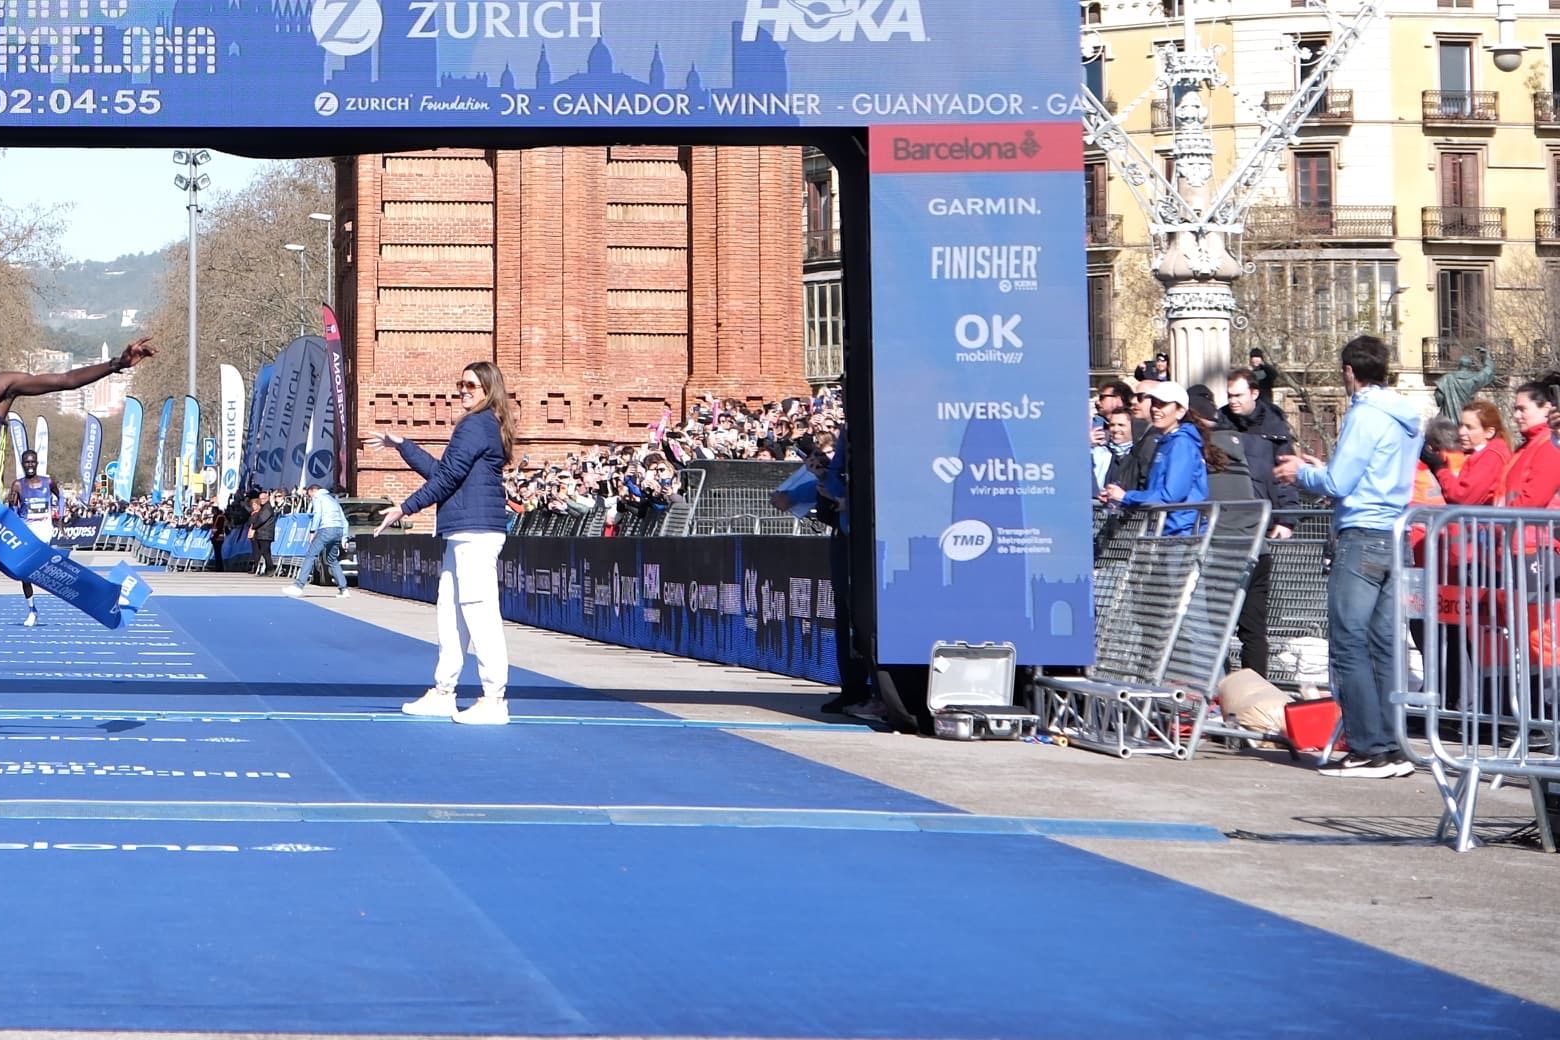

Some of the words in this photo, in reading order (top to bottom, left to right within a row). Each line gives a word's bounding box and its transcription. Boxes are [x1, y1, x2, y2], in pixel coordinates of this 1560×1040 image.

[407, 1, 602, 39] ZURICH
[345, 97, 409, 111] ZURICH
[418, 94, 490, 112] Foundation
[552, 94, 690, 116] GANADOR
[717, 94, 821, 116] WINNER
[851, 93, 1024, 116] GUANYADOR
[893, 137, 1018, 160] Barcelona
[931, 245, 1038, 280] FINISHER
[954, 313, 1024, 350] OK
[956, 351, 1011, 363] mobility
[969, 461, 1055, 482] vithas
[970, 486, 990, 495] vivir
[992, 487, 1014, 496] para
[1016, 485, 1056, 495] cuidarte
[952, 535, 985, 546] TMB
[1010, 545, 1051, 554] Barcelona
